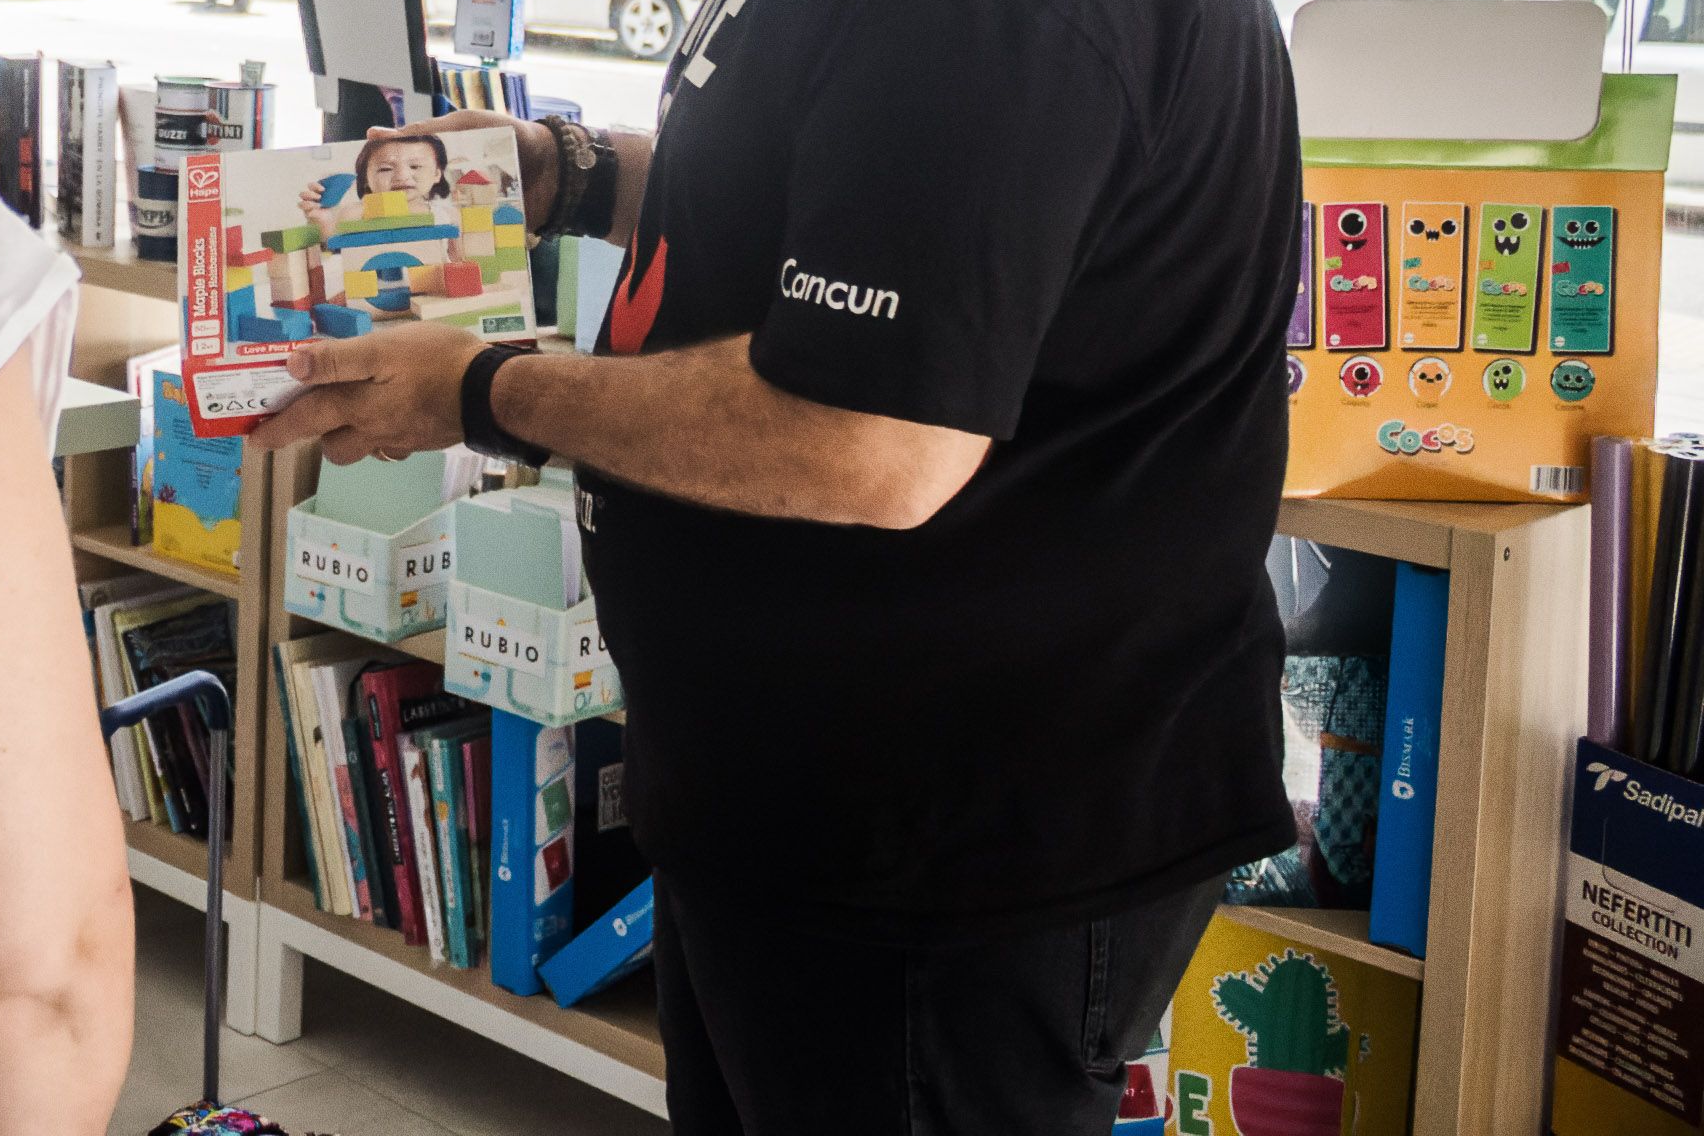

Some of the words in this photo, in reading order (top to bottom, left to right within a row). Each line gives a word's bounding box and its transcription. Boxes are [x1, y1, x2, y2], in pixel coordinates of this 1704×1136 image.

[190, 187, 220, 199] Hape
[193, 238, 205, 275] Blocks
[194, 278, 207, 317] Maple
[780, 257, 899, 320] Cancun
[302, 550, 369, 583] RUBIO
[464, 626, 539, 663] RUBIO
[1582, 879, 1692, 948] NEFERTITI
[1591, 910, 1679, 961] COLLECTION
